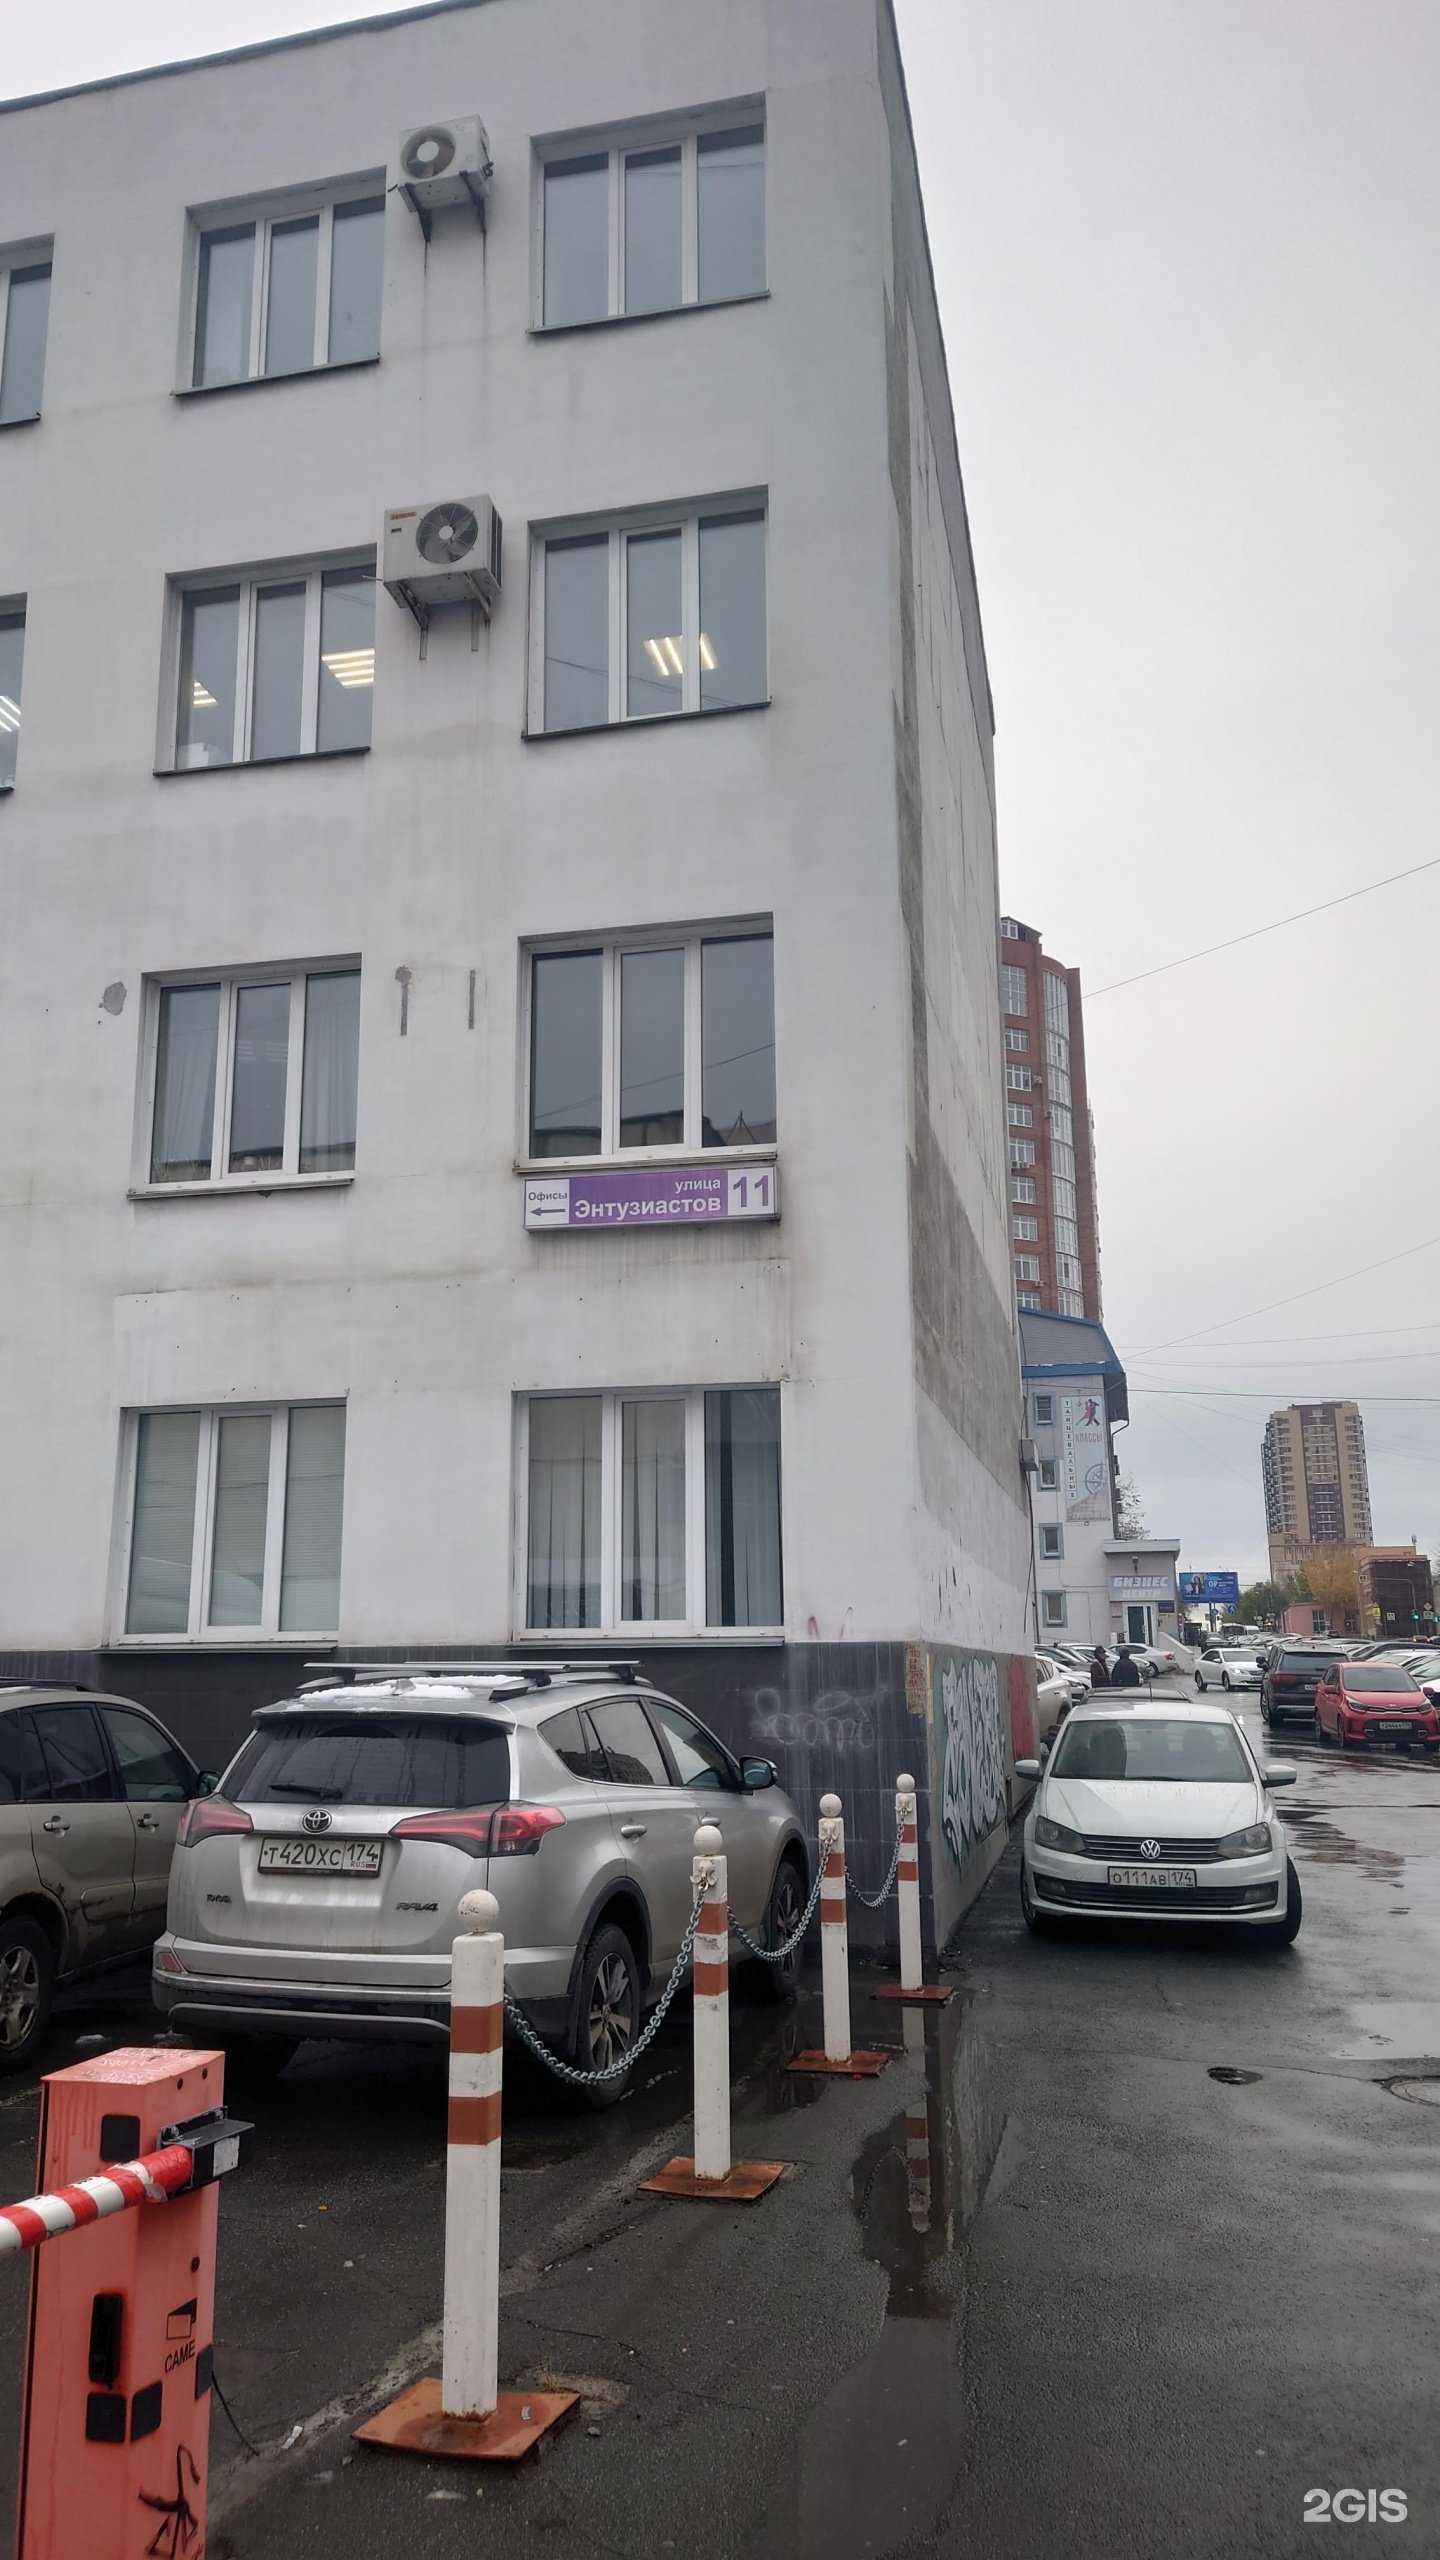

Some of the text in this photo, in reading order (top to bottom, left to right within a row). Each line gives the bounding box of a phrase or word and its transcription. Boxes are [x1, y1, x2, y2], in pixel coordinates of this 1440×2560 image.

[675, 1178, 721, 1193] улица
[732, 1175, 769, 1208] 11
[528, 1191, 568, 1202] Офисы
[574, 1197, 721, 1221] Энтузиастов
[1113, 1577, 1168, 1587] БИЗНЕС
[269, 1843, 377, 1866] Т420ХС 174
[1171, 1872, 1194, 1884] 174
[165, 2339, 195, 2374] CAME
